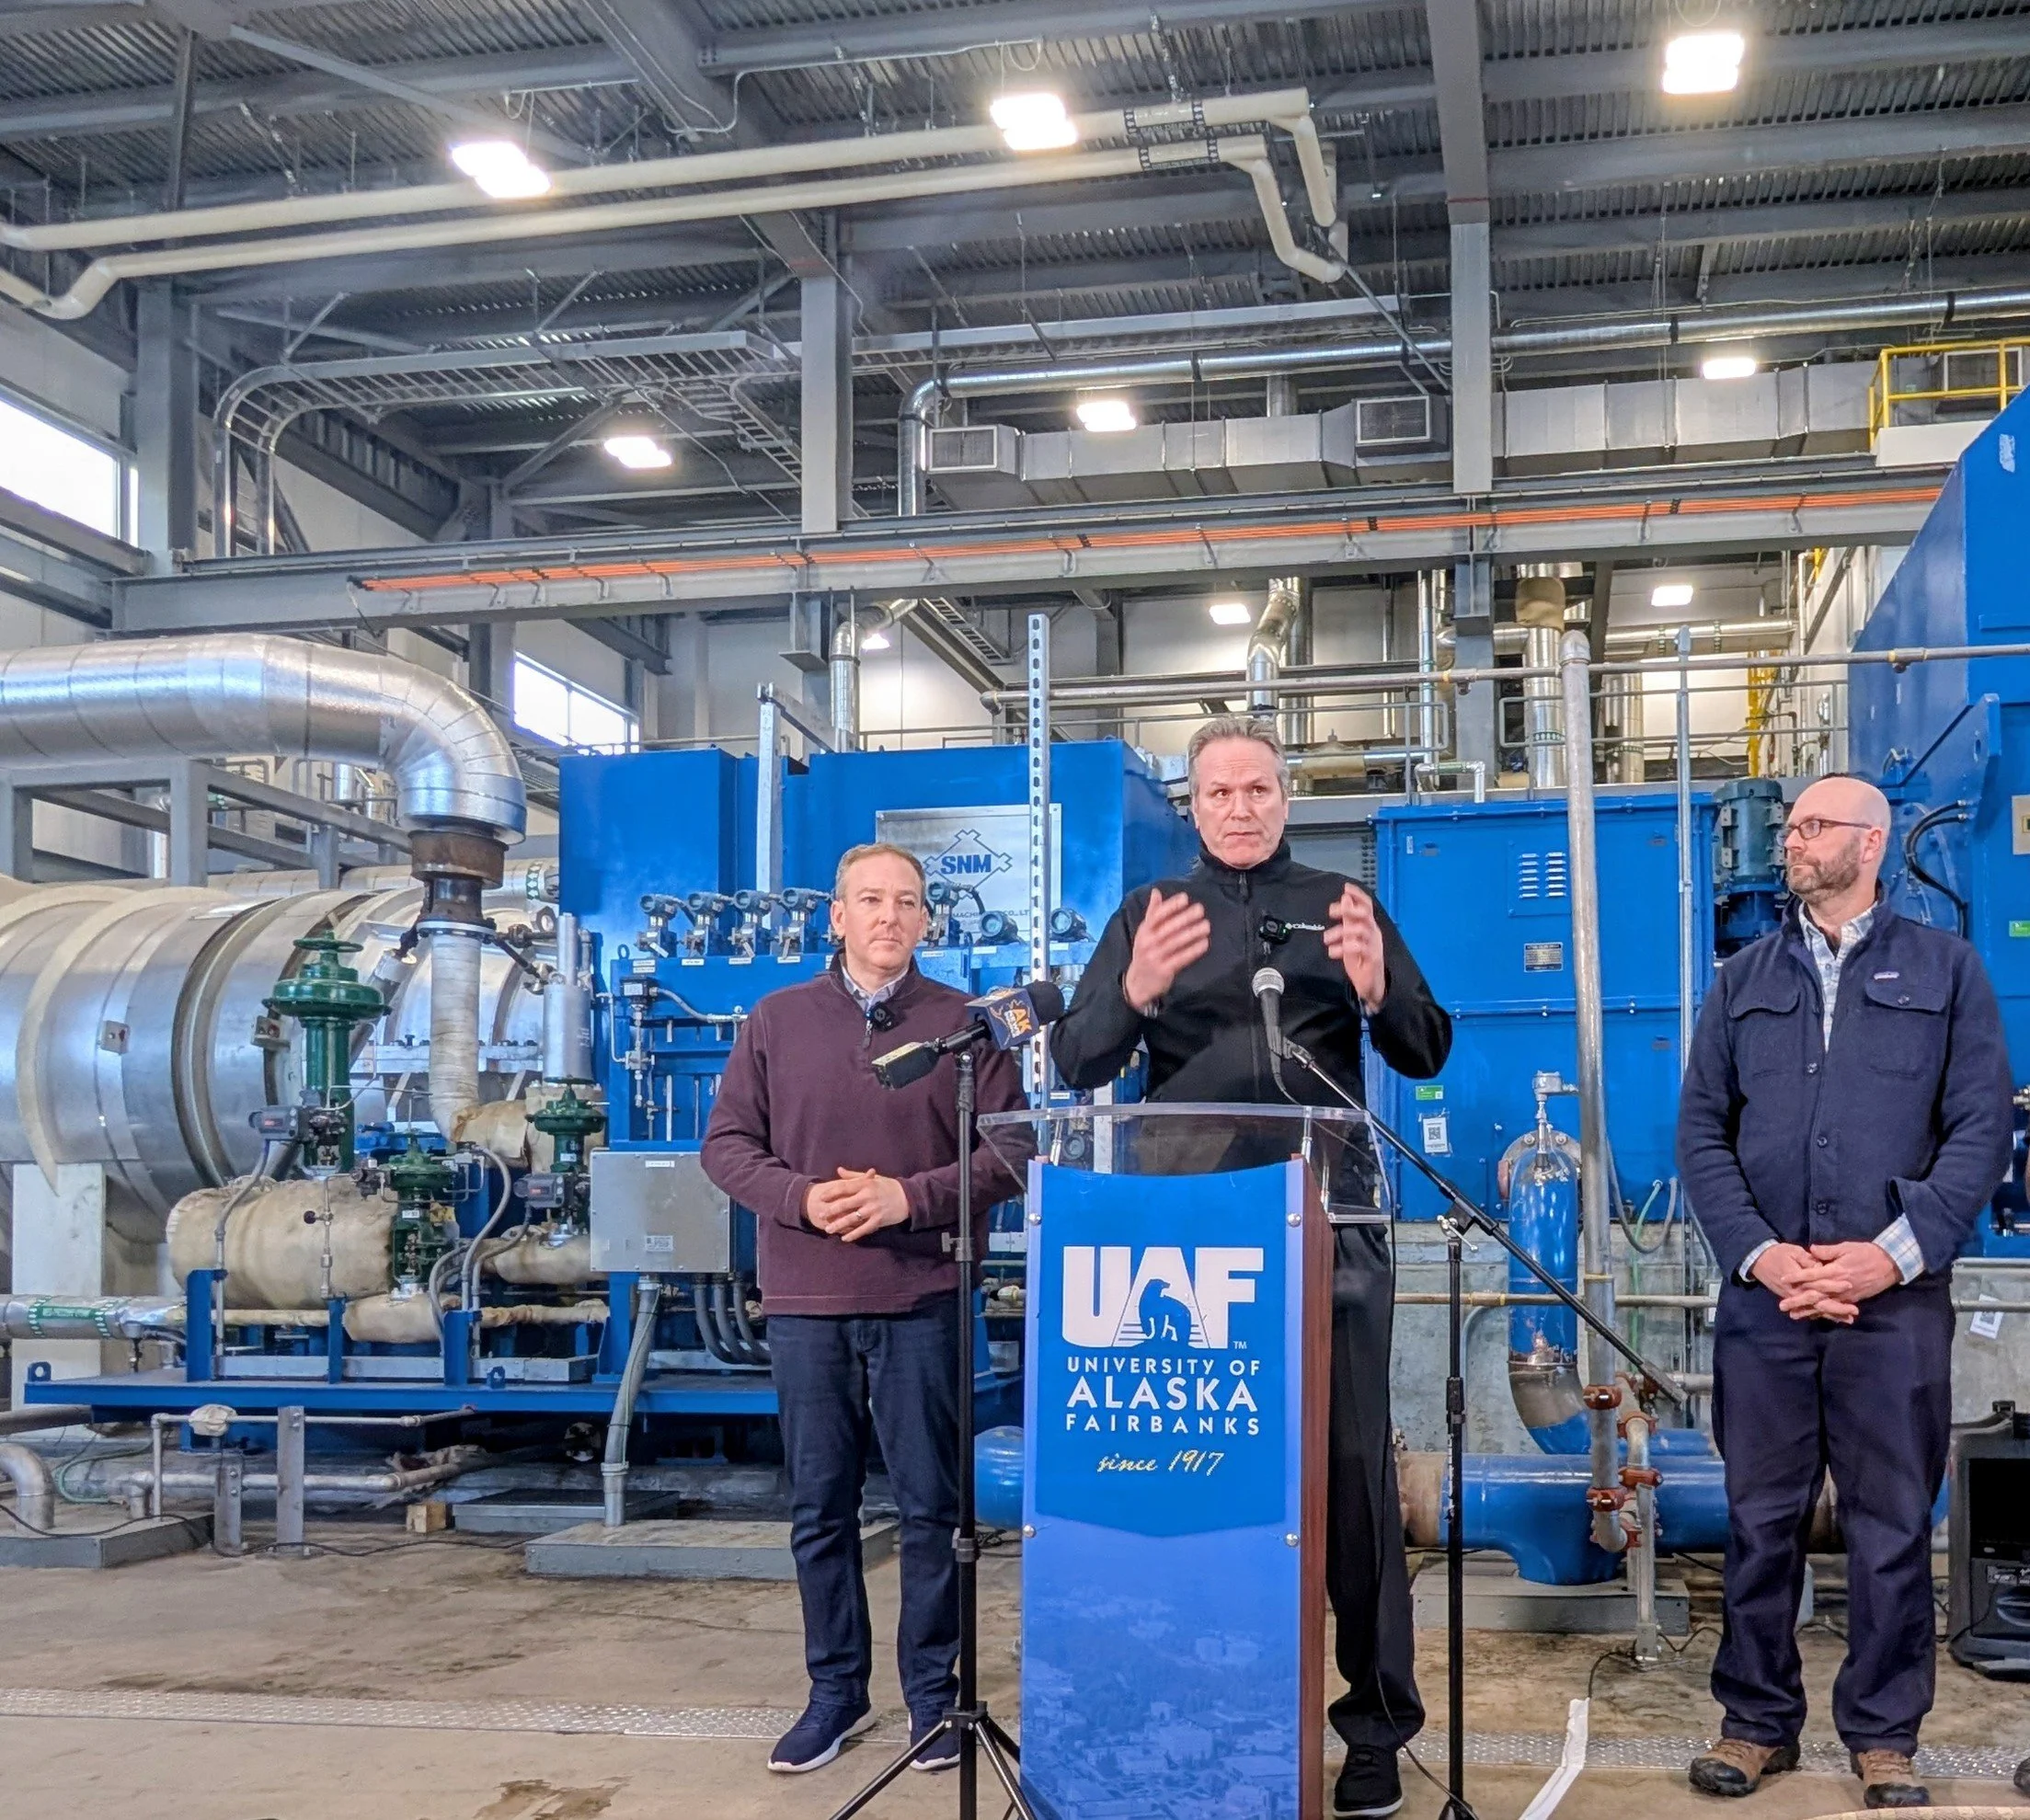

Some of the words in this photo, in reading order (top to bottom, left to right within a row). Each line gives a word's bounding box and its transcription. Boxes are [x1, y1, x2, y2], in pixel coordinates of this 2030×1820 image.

[940, 853, 992, 875] SNM
[1012, 1008, 1033, 1032] AK
[1061, 1245, 1265, 1349] UAF
[1067, 1356, 1214, 1375] UNIVERSITY
[1229, 1359, 1261, 1376] OF
[1066, 1375, 1258, 1413] ALASKA
[1066, 1414, 1260, 1436] FAIRBANKS
[1096, 1452, 1158, 1472] since
[1167, 1449, 1225, 1477] 1917
